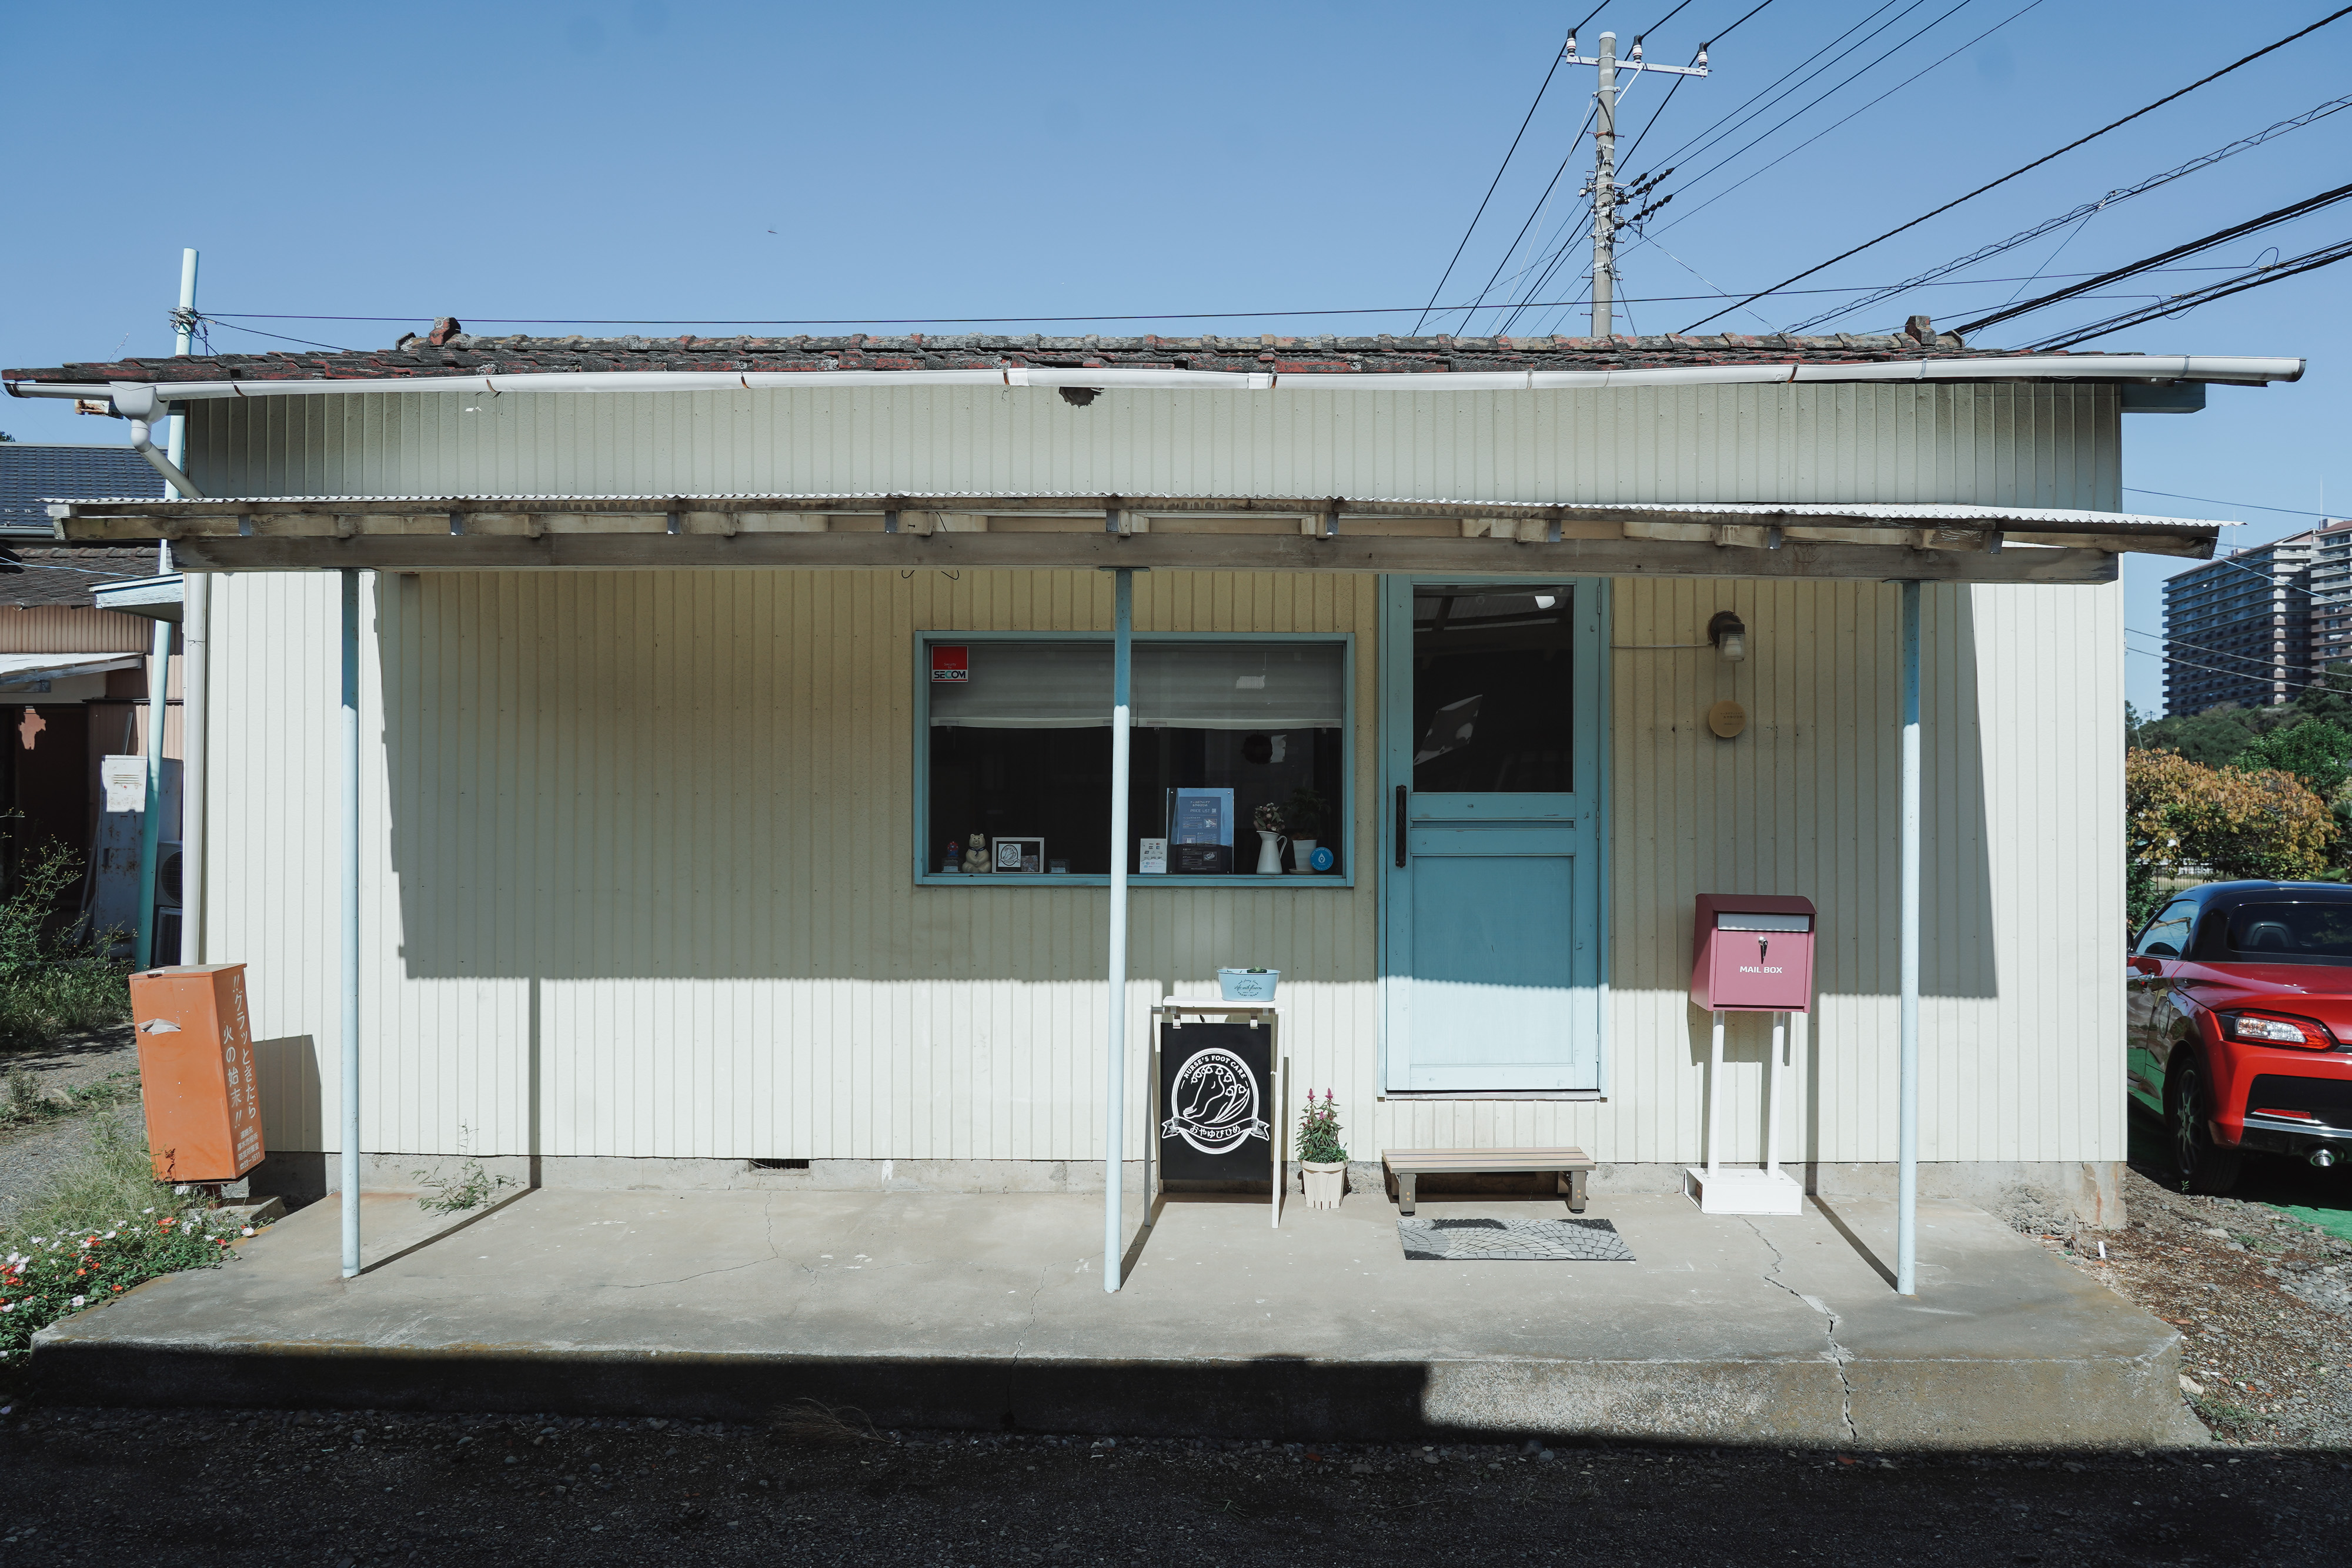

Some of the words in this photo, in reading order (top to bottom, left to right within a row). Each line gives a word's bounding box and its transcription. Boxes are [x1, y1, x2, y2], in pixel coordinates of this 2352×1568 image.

[934, 670, 966, 678] SECOM
[1184, 1056, 1210, 1079] NURSE'S
[1211, 1055, 1231, 1064] FOOT
[1230, 1061, 1247, 1079] CARE
[1190, 1124, 1241, 1139] おやゆびひめ
